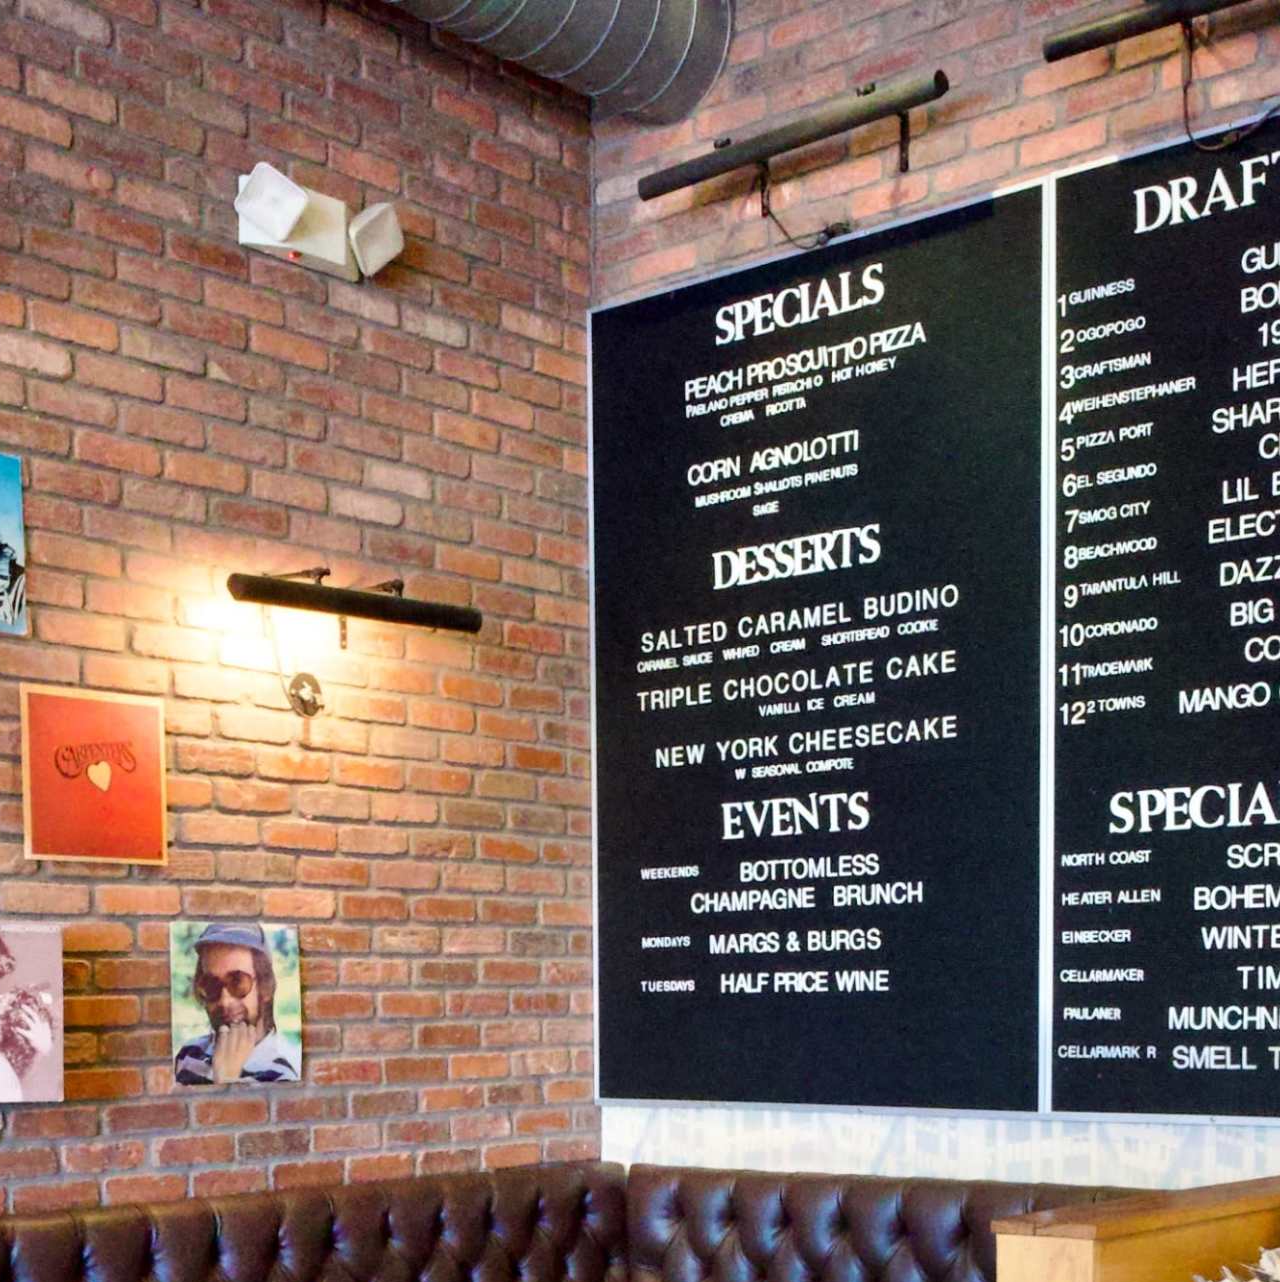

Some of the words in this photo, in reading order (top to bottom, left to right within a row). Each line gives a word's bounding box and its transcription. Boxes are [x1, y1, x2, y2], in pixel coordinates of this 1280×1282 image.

[715, 262, 885, 346] SPECIALS
[1068, 277, 1136, 306] GUINNESS
[1059, 328, 1075, 354] 2
[1075, 315, 1147, 343] OGOPOGO
[684, 367, 743, 402] PEACH
[869, 321, 927, 356] PIZZA
[1059, 364, 1075, 390] 3
[1075, 351, 1152, 380] CRAFTSMAN
[1058, 401, 1073, 425] 4
[687, 455, 741, 487] CORN
[749, 429, 859, 473] AGNOLOTTI
[1060, 437, 1076, 462] 5
[1118, 421, 1154, 442] PORT
[1062, 472, 1077, 498] 6
[1076, 474, 1094, 491] EL
[1096, 462, 1157, 486] SEGUNDO
[1222, 476, 1259, 505] LIL
[1064, 508, 1079, 534] 7
[1078, 505, 1118, 525] SMOG
[1119, 500, 1151, 518] CITY
[711, 523, 881, 590] DESSERTS
[1063, 545, 1079, 570] 8
[1077, 536, 1158, 562] BEACHWOOD
[1063, 584, 1079, 609] 9
[1152, 570, 1181, 586] HILL
[641, 620, 728, 653] SALTED
[737, 601, 852, 639] CARAMEL
[863, 583, 959, 620] BUDINO
[1230, 597, 1275, 627] BIG
[1059, 622, 1086, 648] 10
[1084, 616, 1159, 639] CORONADO
[636, 682, 713, 712] TRIPLE
[723, 660, 874, 701] CHOCOLATE
[886, 649, 957, 680] CAKE
[1058, 662, 1082, 687] 11
[1080, 657, 1154, 678] TRADEMARK
[806, 697, 825, 711] ICE
[1059, 701, 1086, 726] 12
[1086, 700, 1096, 714] 2
[1097, 695, 1146, 712] TOWNS
[1178, 681, 1272, 714] MANGO
[655, 743, 706, 769] NEW
[716, 735, 779, 761] YORK
[788, 715, 958, 755] CHEESECAKE
[720, 791, 870, 840] EVENTS
[640, 864, 700, 880] WEEKENDS
[739, 853, 880, 883] BOTTOMLESS
[1061, 852, 1106, 867] NORTH
[1108, 849, 1152, 865] COAST
[690, 886, 816, 914] CHAMPAGNE
[833, 881, 923, 907] BRUNCH
[1061, 890, 1113, 906] HEATER
[1116, 888, 1161, 904] ALLEN
[709, 931, 781, 955] MARGS
[785, 930, 801, 953] &
[807, 927, 882, 952] BURGS
[1061, 928, 1132, 945] EINBECKER
[640, 979, 696, 993] TUESDAYS
[720, 972, 770, 994] HALF
[773, 970, 829, 993] PRICE
[834, 969, 890, 993] WINE
[1146, 1045, 1157, 1059] R
[1172, 1045, 1258, 1070] SMELL
